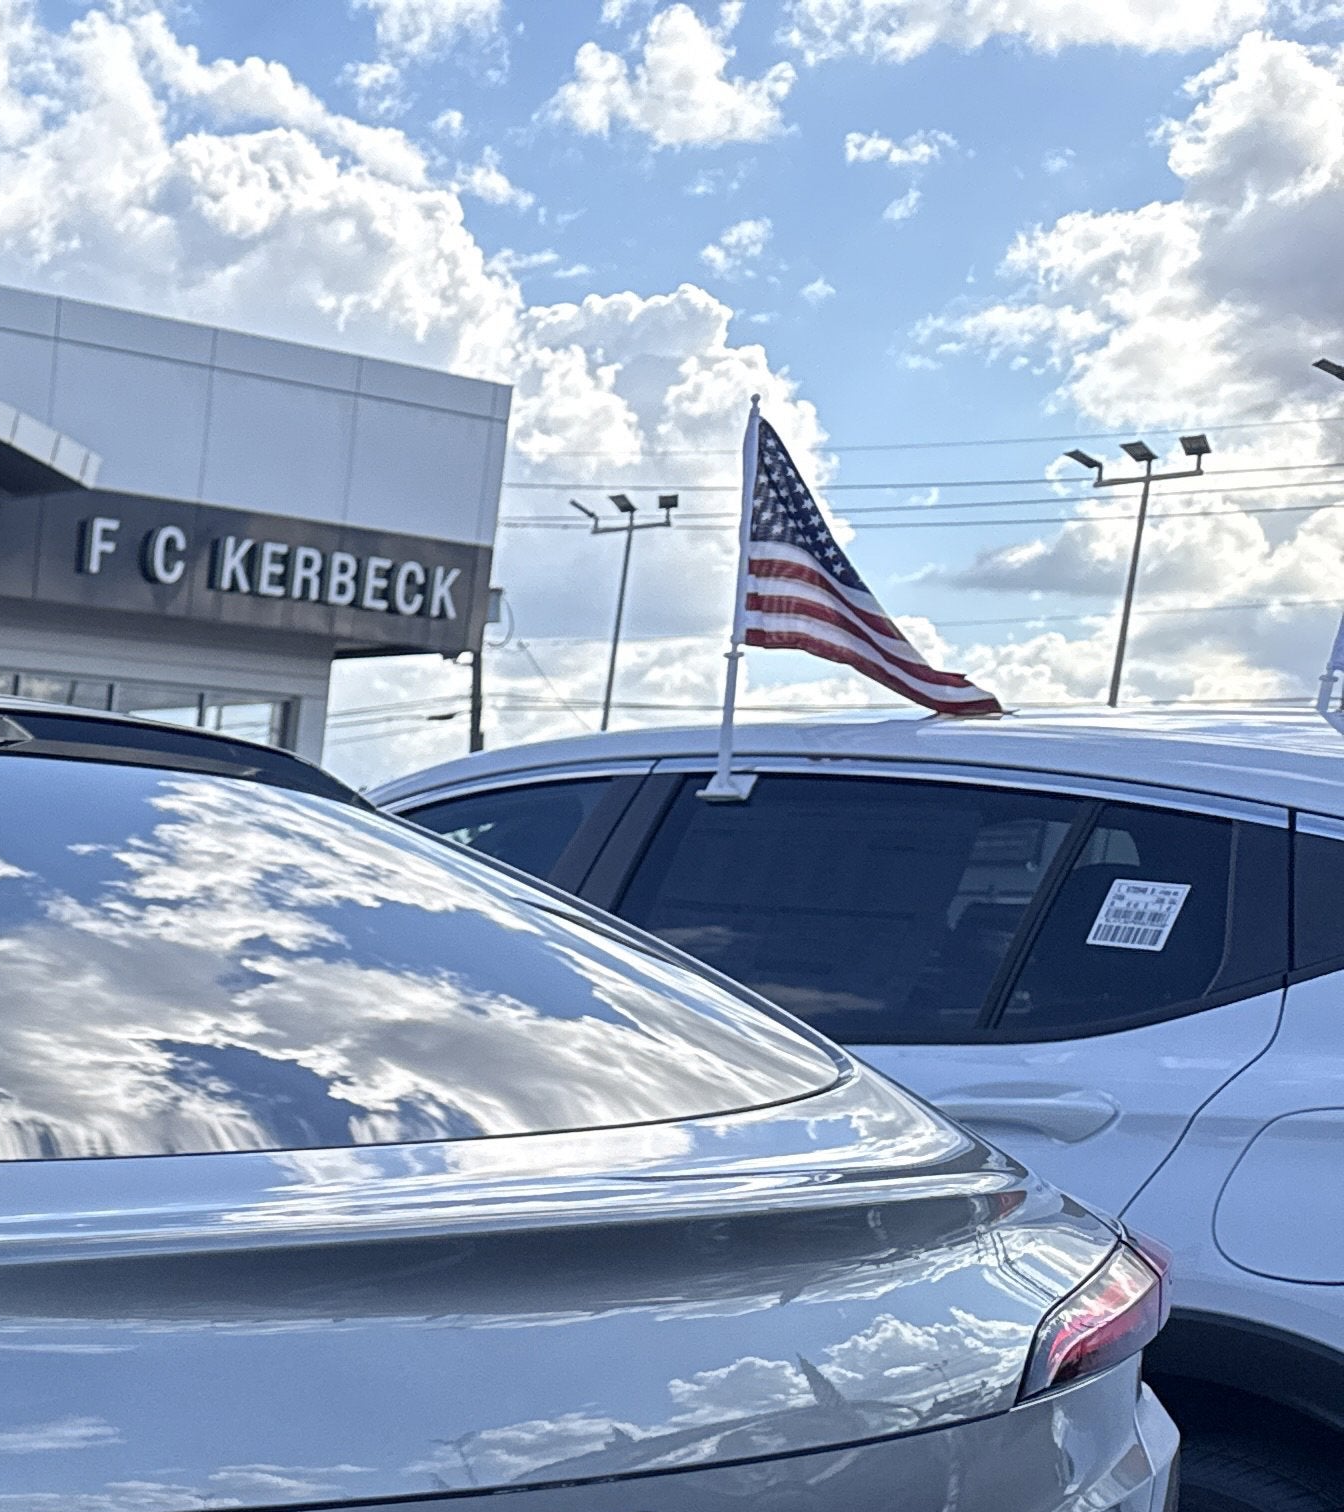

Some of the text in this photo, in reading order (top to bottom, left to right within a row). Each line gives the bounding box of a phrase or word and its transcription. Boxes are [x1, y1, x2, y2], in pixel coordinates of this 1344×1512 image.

[88, 516, 462, 620] F C KERBECK
